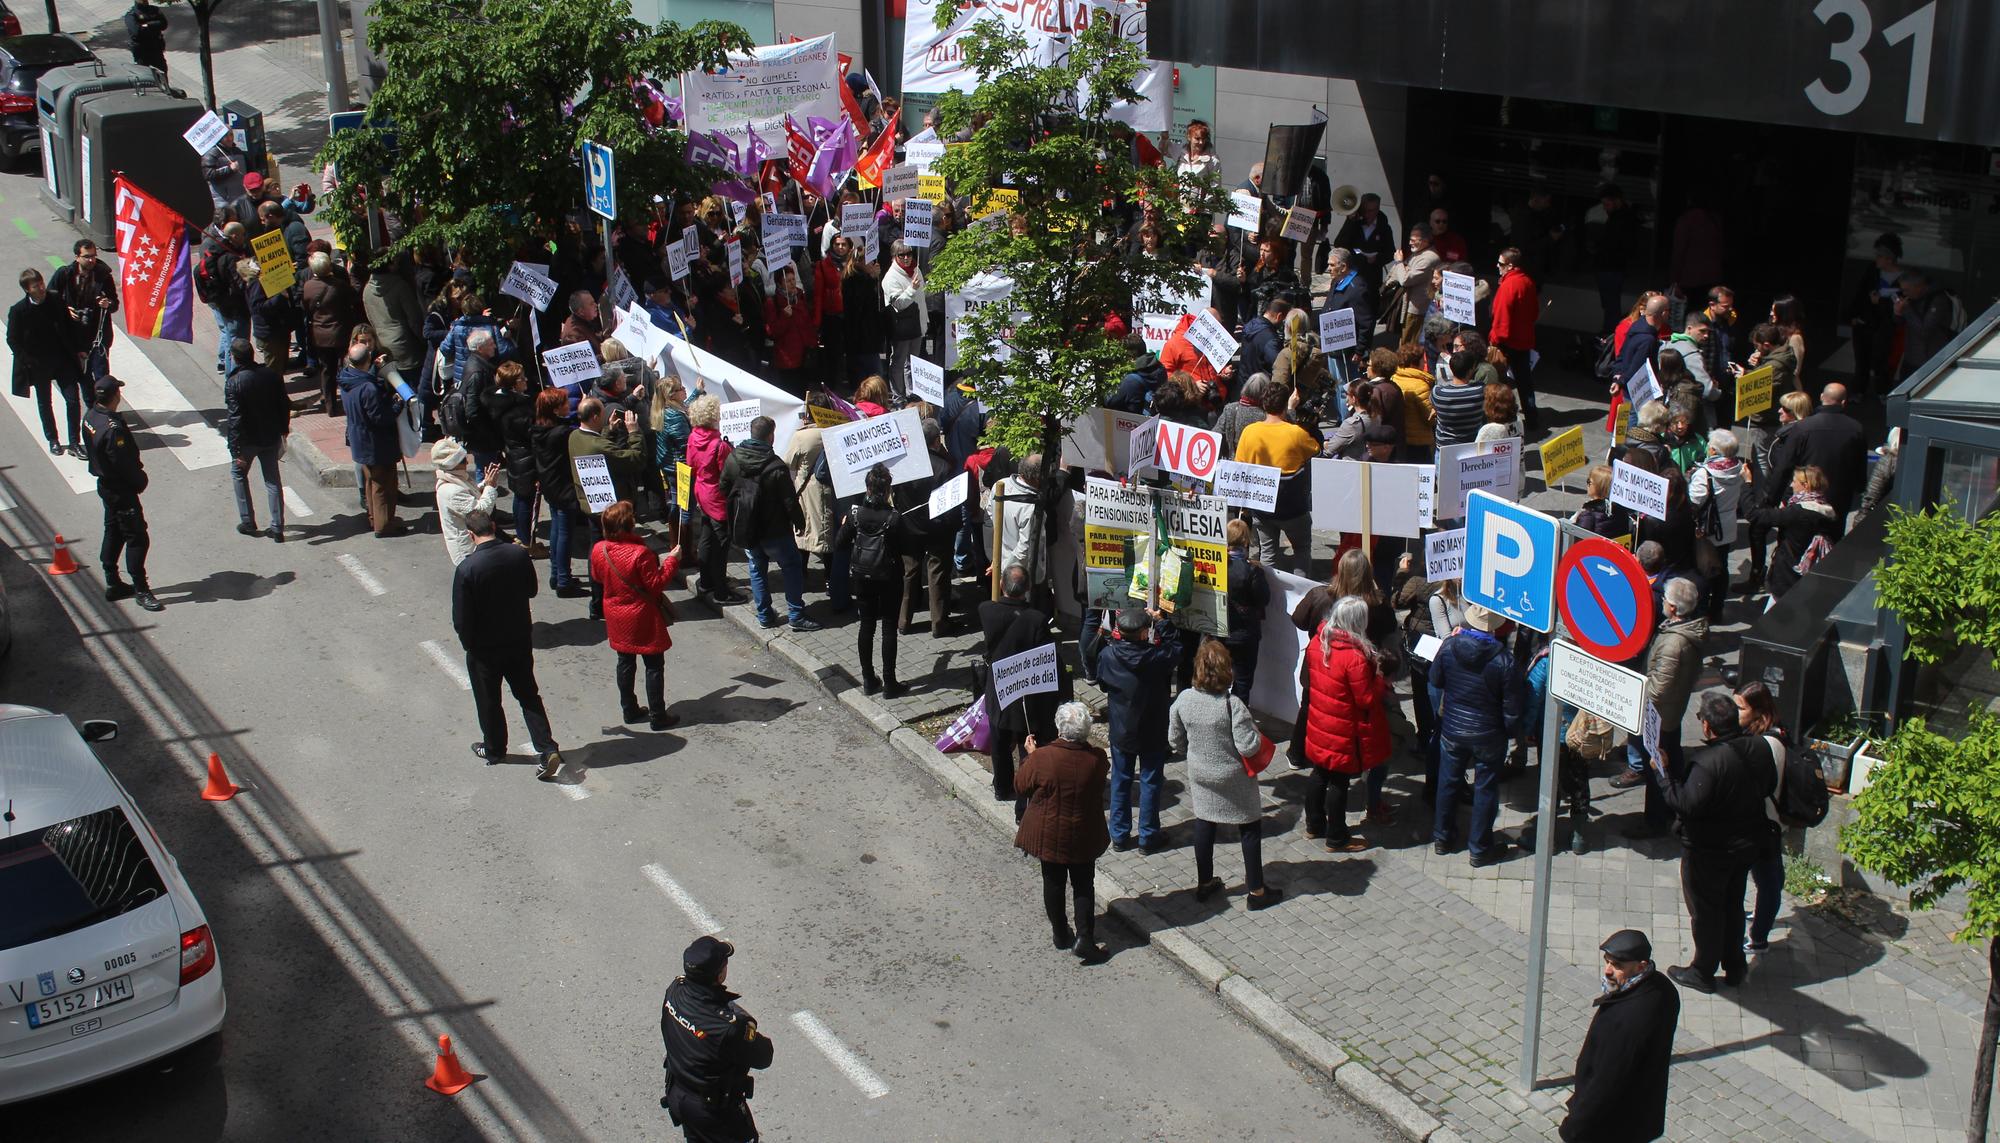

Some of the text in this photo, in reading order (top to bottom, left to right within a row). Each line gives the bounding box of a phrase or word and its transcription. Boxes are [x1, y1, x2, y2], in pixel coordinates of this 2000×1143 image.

[1804, 0, 1937, 125] 31
[744, 81, 831, 98] FALTA DE PERSONAL
[227, 112, 238, 127] P
[907, 201, 932, 212] SERVICIOS
[906, 215, 931, 226] SOCIALES
[905, 229, 930, 240] DIGNOS.
[524, 272, 556, 297] GERIATRAS
[1188, 326, 1196, 335] en
[1195, 331, 1214, 353] centros
[559, 349, 592, 363] GERIATRAS
[551, 368, 557, 378] Y
[721, 411, 729, 420] NO
[740, 405, 760, 418] MUERTES
[722, 424, 732, 434] POR
[844, 422, 892, 448] MIS MAYORES
[846, 437, 902, 465] SON TUS MAYORES
[1154, 424, 1217, 477] NO
[1494, 445, 1511, 453] NO+
[577, 457, 606, 470] SERVICIOS
[1461, 459, 1494, 473] Derechos
[581, 475, 611, 488] SOCIALES
[1220, 468, 1231, 485] Ley
[1232, 470, 1240, 482] de
[1240, 471, 1278, 488] Residencias.
[1460, 479, 1493, 491] humanos
[1617, 467, 1662, 496] MIS MAYORES
[587, 492, 616, 505] DIGNOS.
[1090, 486, 1147, 507] PARA PARADOS
[1218, 486, 1275, 505] Inspecciones eficaces.
[1612, 483, 1665, 515] SON TUS MAYORES
[1088, 504, 1149, 525] Y PENSIONISTAS
[1214, 501, 1224, 511] LA
[1166, 509, 1224, 538] IGLESIA
[1089, 532, 1107, 541] PARA
[1433, 541, 1446, 554] MIS
[1480, 510, 1535, 598] P
[1091, 556, 1096, 565] Y
[1429, 560, 1443, 575] SON
[1444, 558, 1457, 571] TUS
[1496, 587, 1505, 603] 2
[1023, 656, 1031, 670] de
[1031, 650, 1055, 668] calidad
[1569, 653, 1594, 670] EXCEPTO
[998, 689, 1006, 700] en
[1005, 677, 1030, 697] centros
[1030, 673, 1041, 686] de
[1578, 667, 1616, 689] AUTORIZADOS
[1595, 683, 1604, 693] DE
[1567, 681, 1624, 713] SOCIALES Y FAMILIA
[1563, 689, 1627, 724] COMUNIDAD DE MADRID
[104, 951, 137, 972] 00005
[40, 979, 126, 1019] 5152 JVH
[665, 1000, 696, 1034] POLICIA
[74, 1019, 99, 1034] SP
